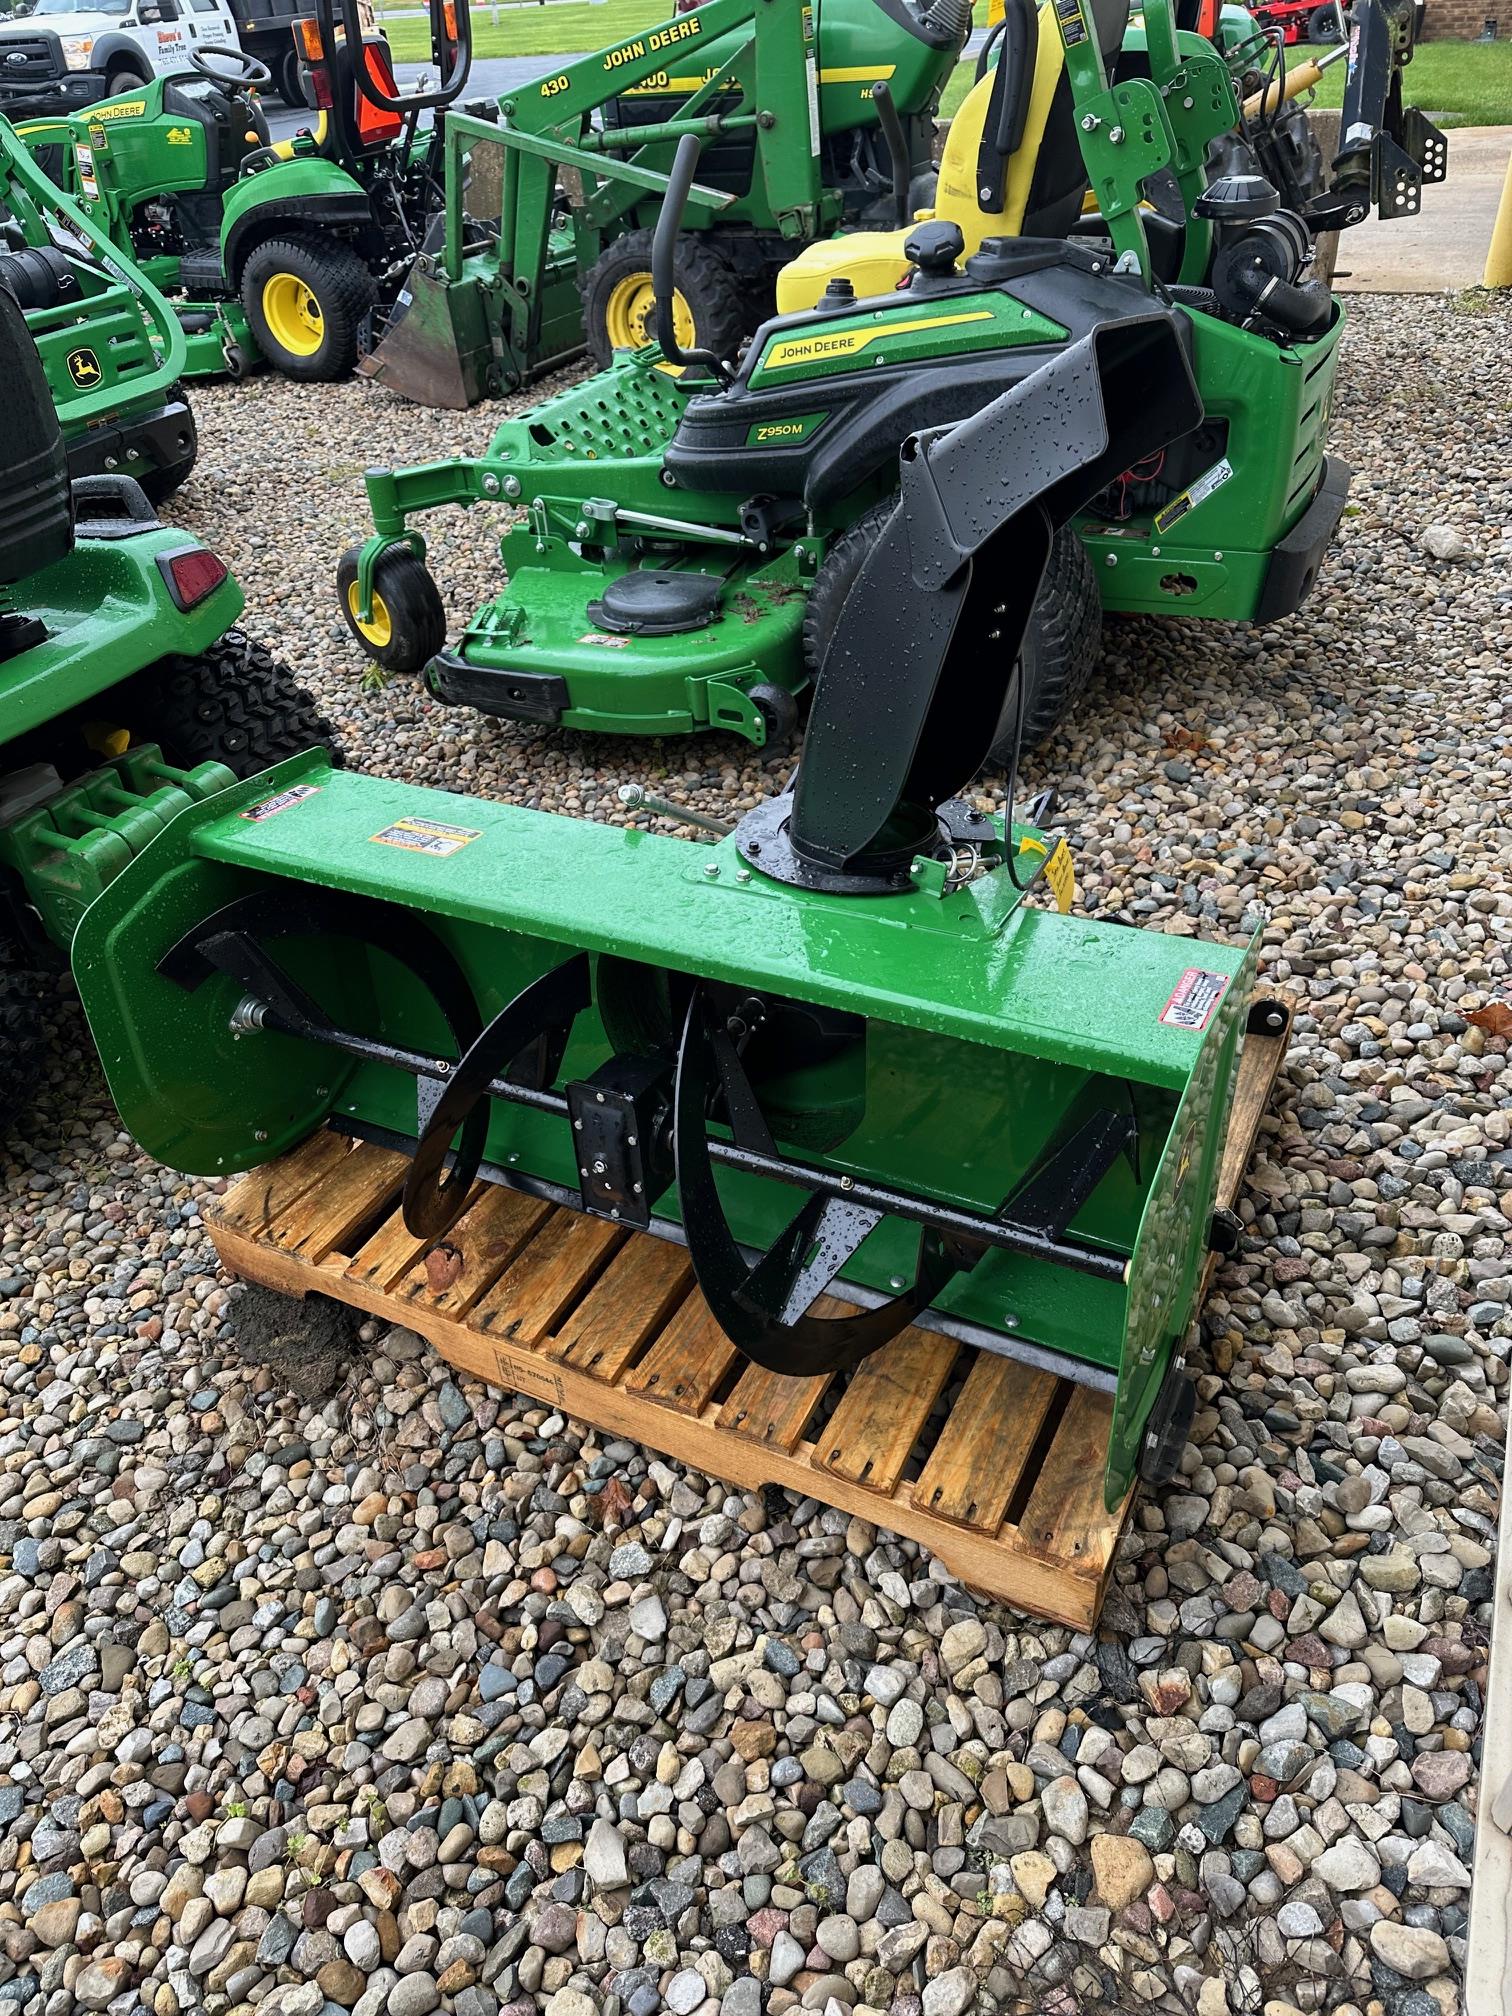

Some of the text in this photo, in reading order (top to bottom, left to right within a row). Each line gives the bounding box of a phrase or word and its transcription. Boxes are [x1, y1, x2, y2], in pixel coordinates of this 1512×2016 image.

[158, 43, 187, 54] Family Tree
[602, 17, 702, 71] JOHN DEERE
[540, 75, 570, 98] 430
[113, 106, 141, 117] DEERE
[780, 337, 855, 359] JOHN DEERE
[757, 424, 803, 441] Z950M
[1173, 971, 1199, 999] DANGER
